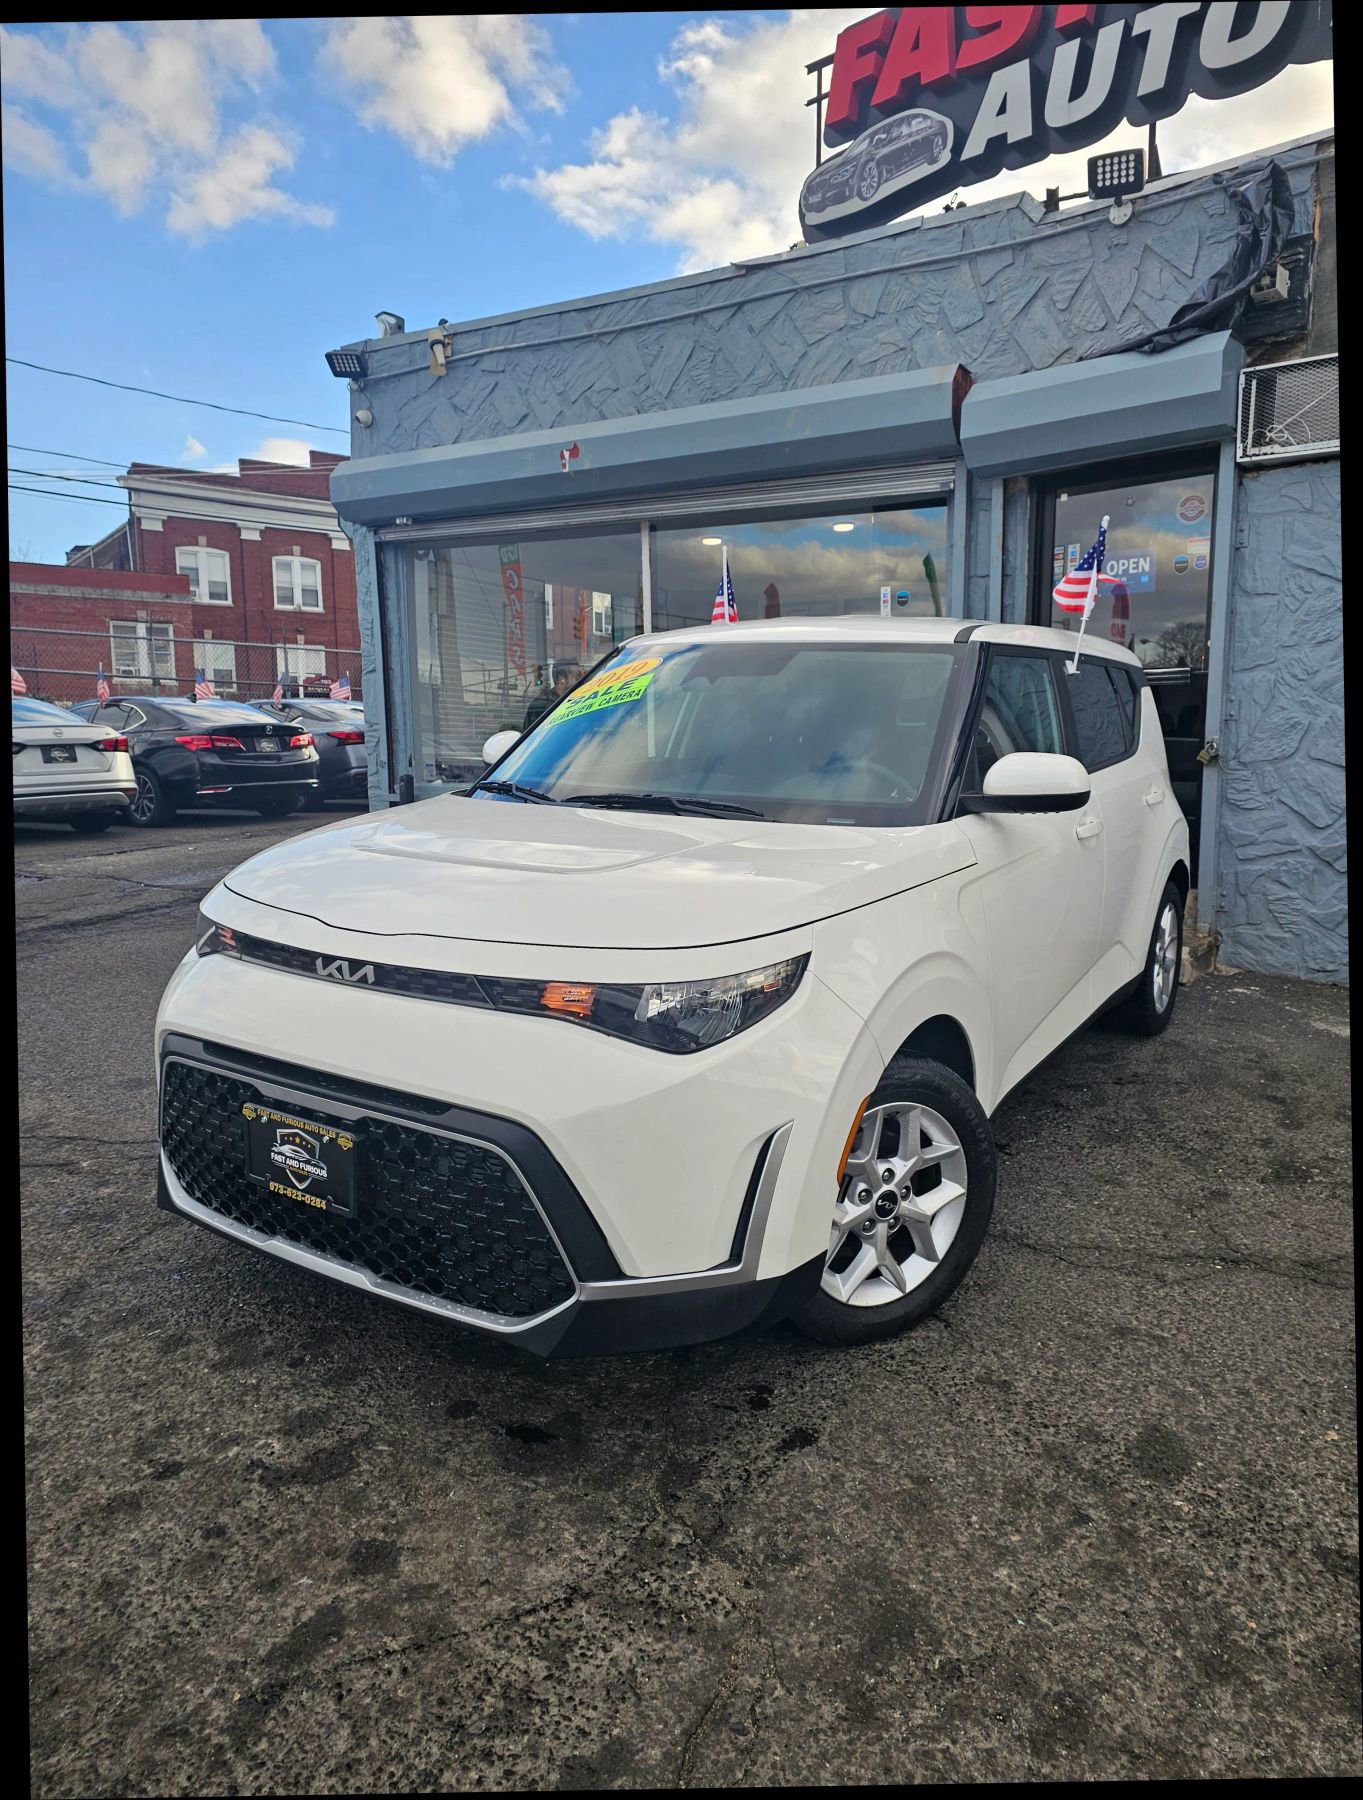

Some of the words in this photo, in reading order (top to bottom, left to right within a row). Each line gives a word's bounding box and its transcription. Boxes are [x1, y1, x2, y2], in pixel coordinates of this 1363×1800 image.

[961, 2, 1289, 161] AUTO
[1106, 556, 1150, 576] OPEN
[581, 661, 648, 694] 2019
[565, 677, 640, 710] SALE
[598, 689, 642, 707] CAMERA
[315, 956, 376, 985] KIA
[257, 1108, 270, 1118] FAST
[270, 1112, 282, 1121] AND
[282, 1116, 304, 1128] FURIOUS
[305, 1122, 318, 1133] AUTO
[319, 1128, 336, 1138] SALES
[270, 1152, 286, 1164] FAST
[285, 1156, 299, 1168] AND
[300, 1162, 328, 1178] FURIOUS
[269, 1181, 327, 1210] 973-623-0284
